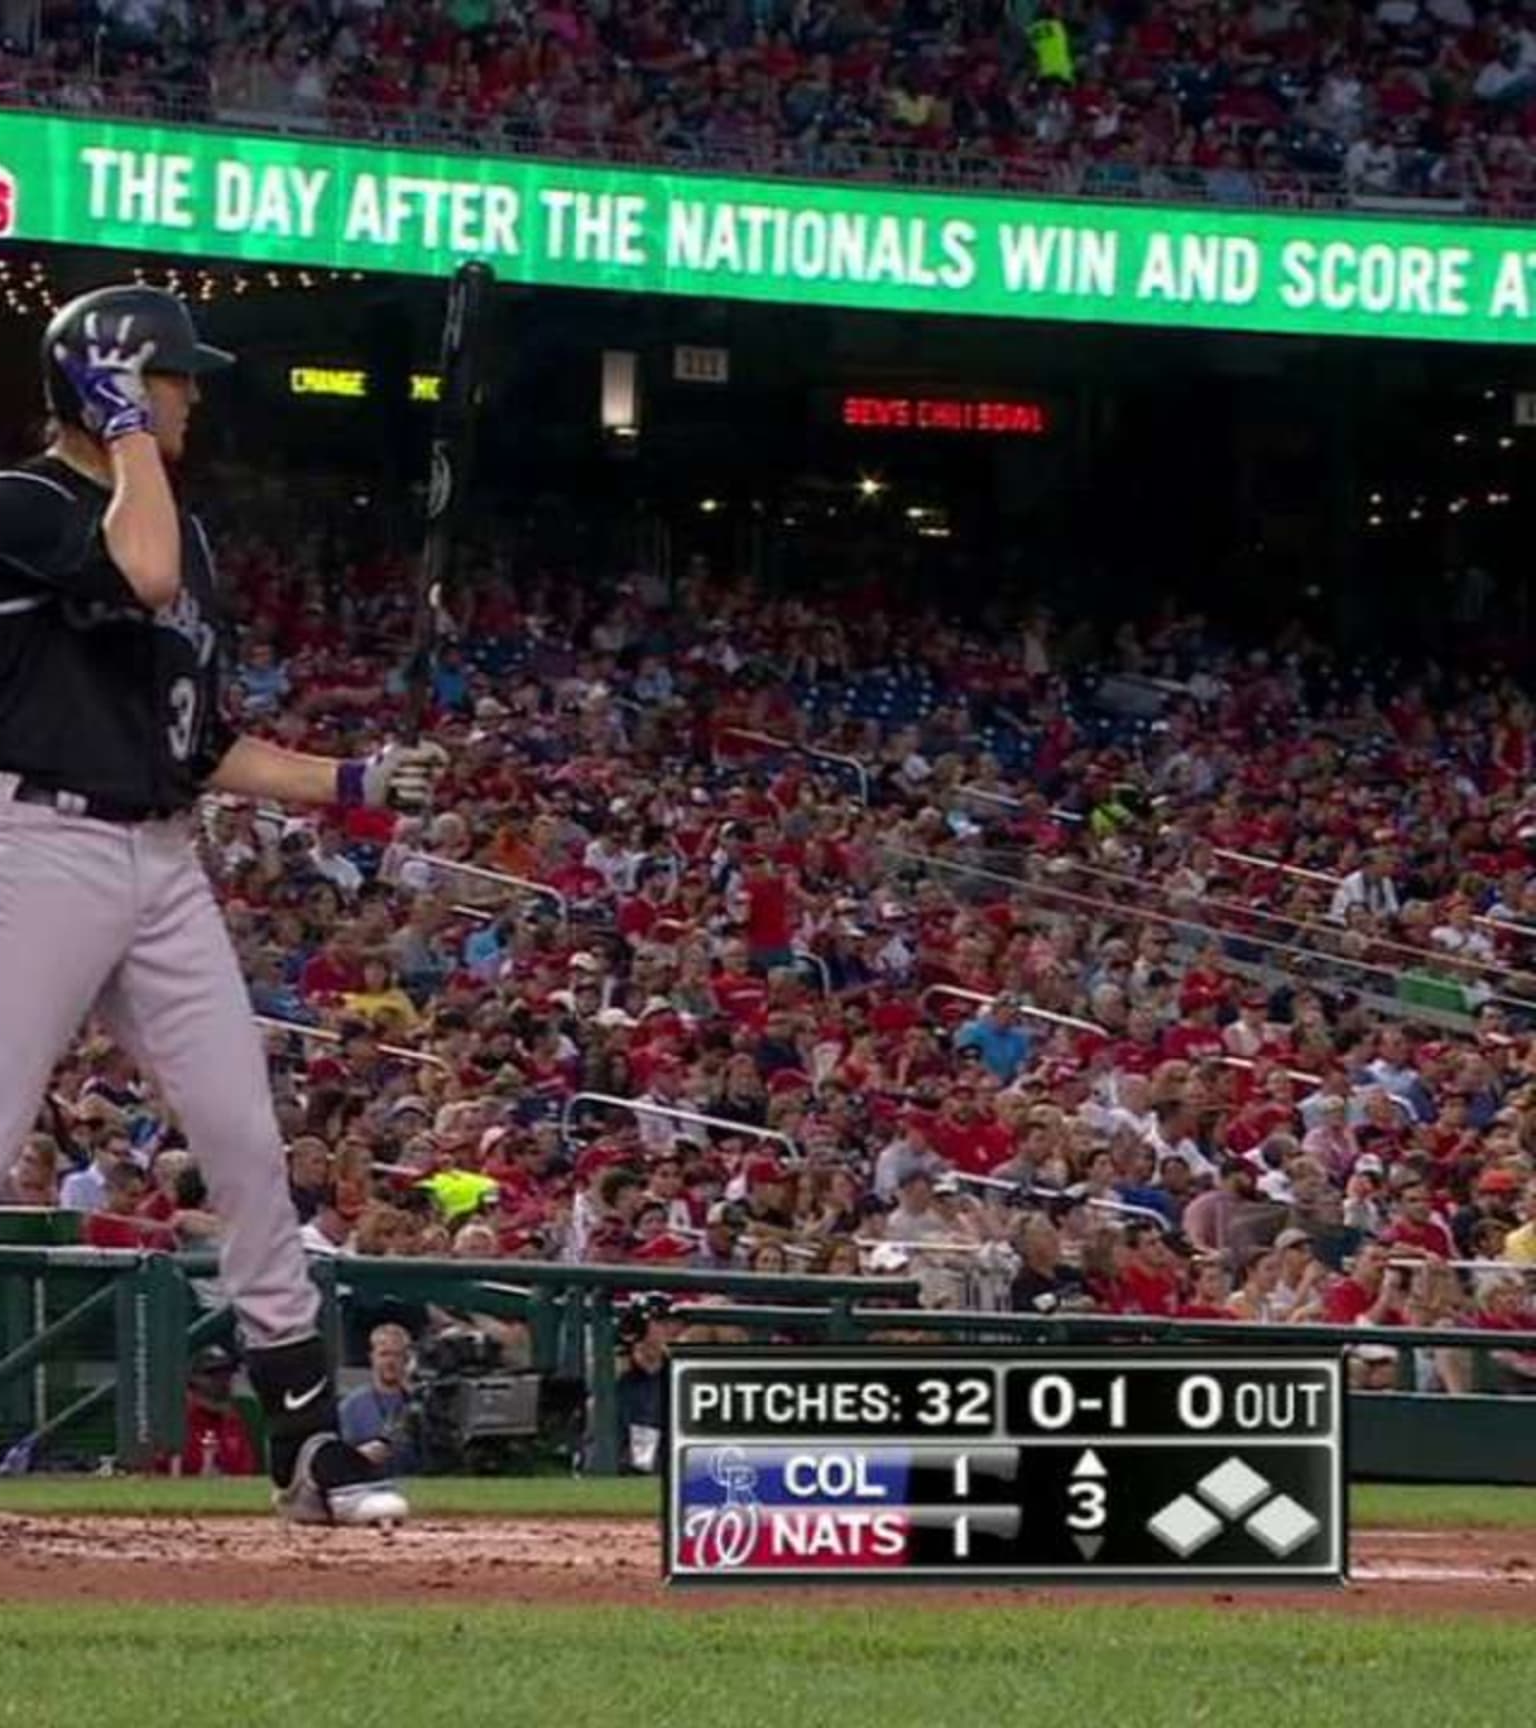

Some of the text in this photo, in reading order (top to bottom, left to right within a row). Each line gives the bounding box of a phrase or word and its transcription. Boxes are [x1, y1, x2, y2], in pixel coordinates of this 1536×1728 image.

[80, 147, 1536, 320] THE DAY AFTER THE NATIONALS WIN AND SCORE A
